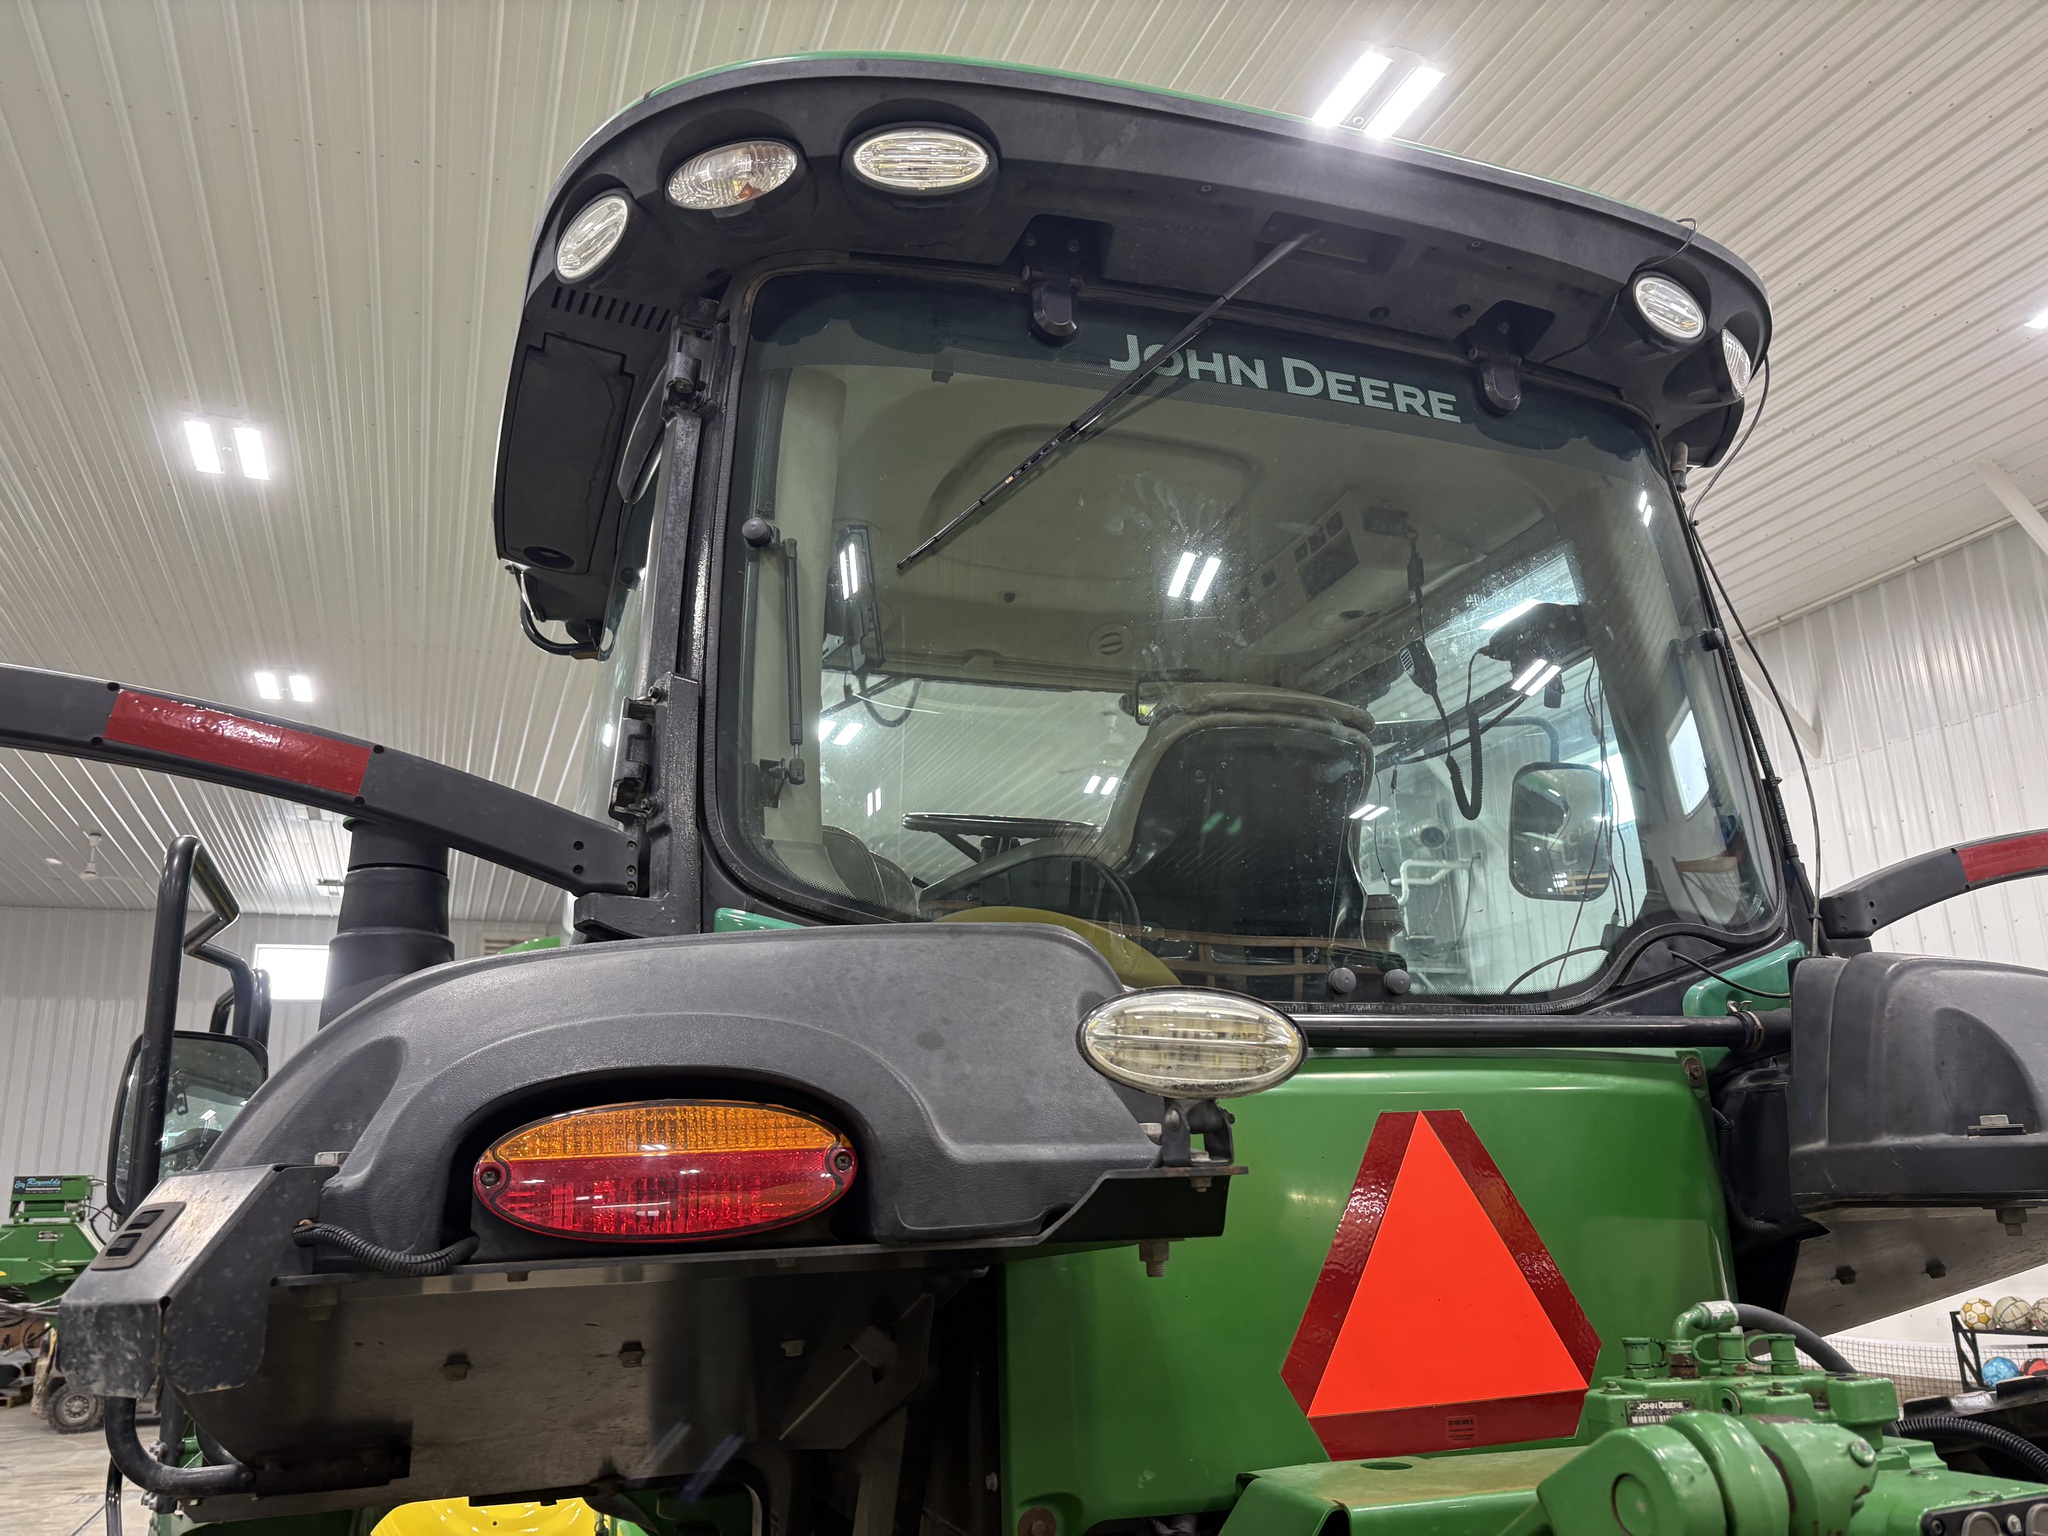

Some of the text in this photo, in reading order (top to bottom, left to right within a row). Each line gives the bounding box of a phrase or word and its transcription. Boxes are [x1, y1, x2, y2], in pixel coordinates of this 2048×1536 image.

[1109, 334, 1461, 423] JOHN DEERE
[1636, 1401, 1684, 1410] JOHN DEERE
